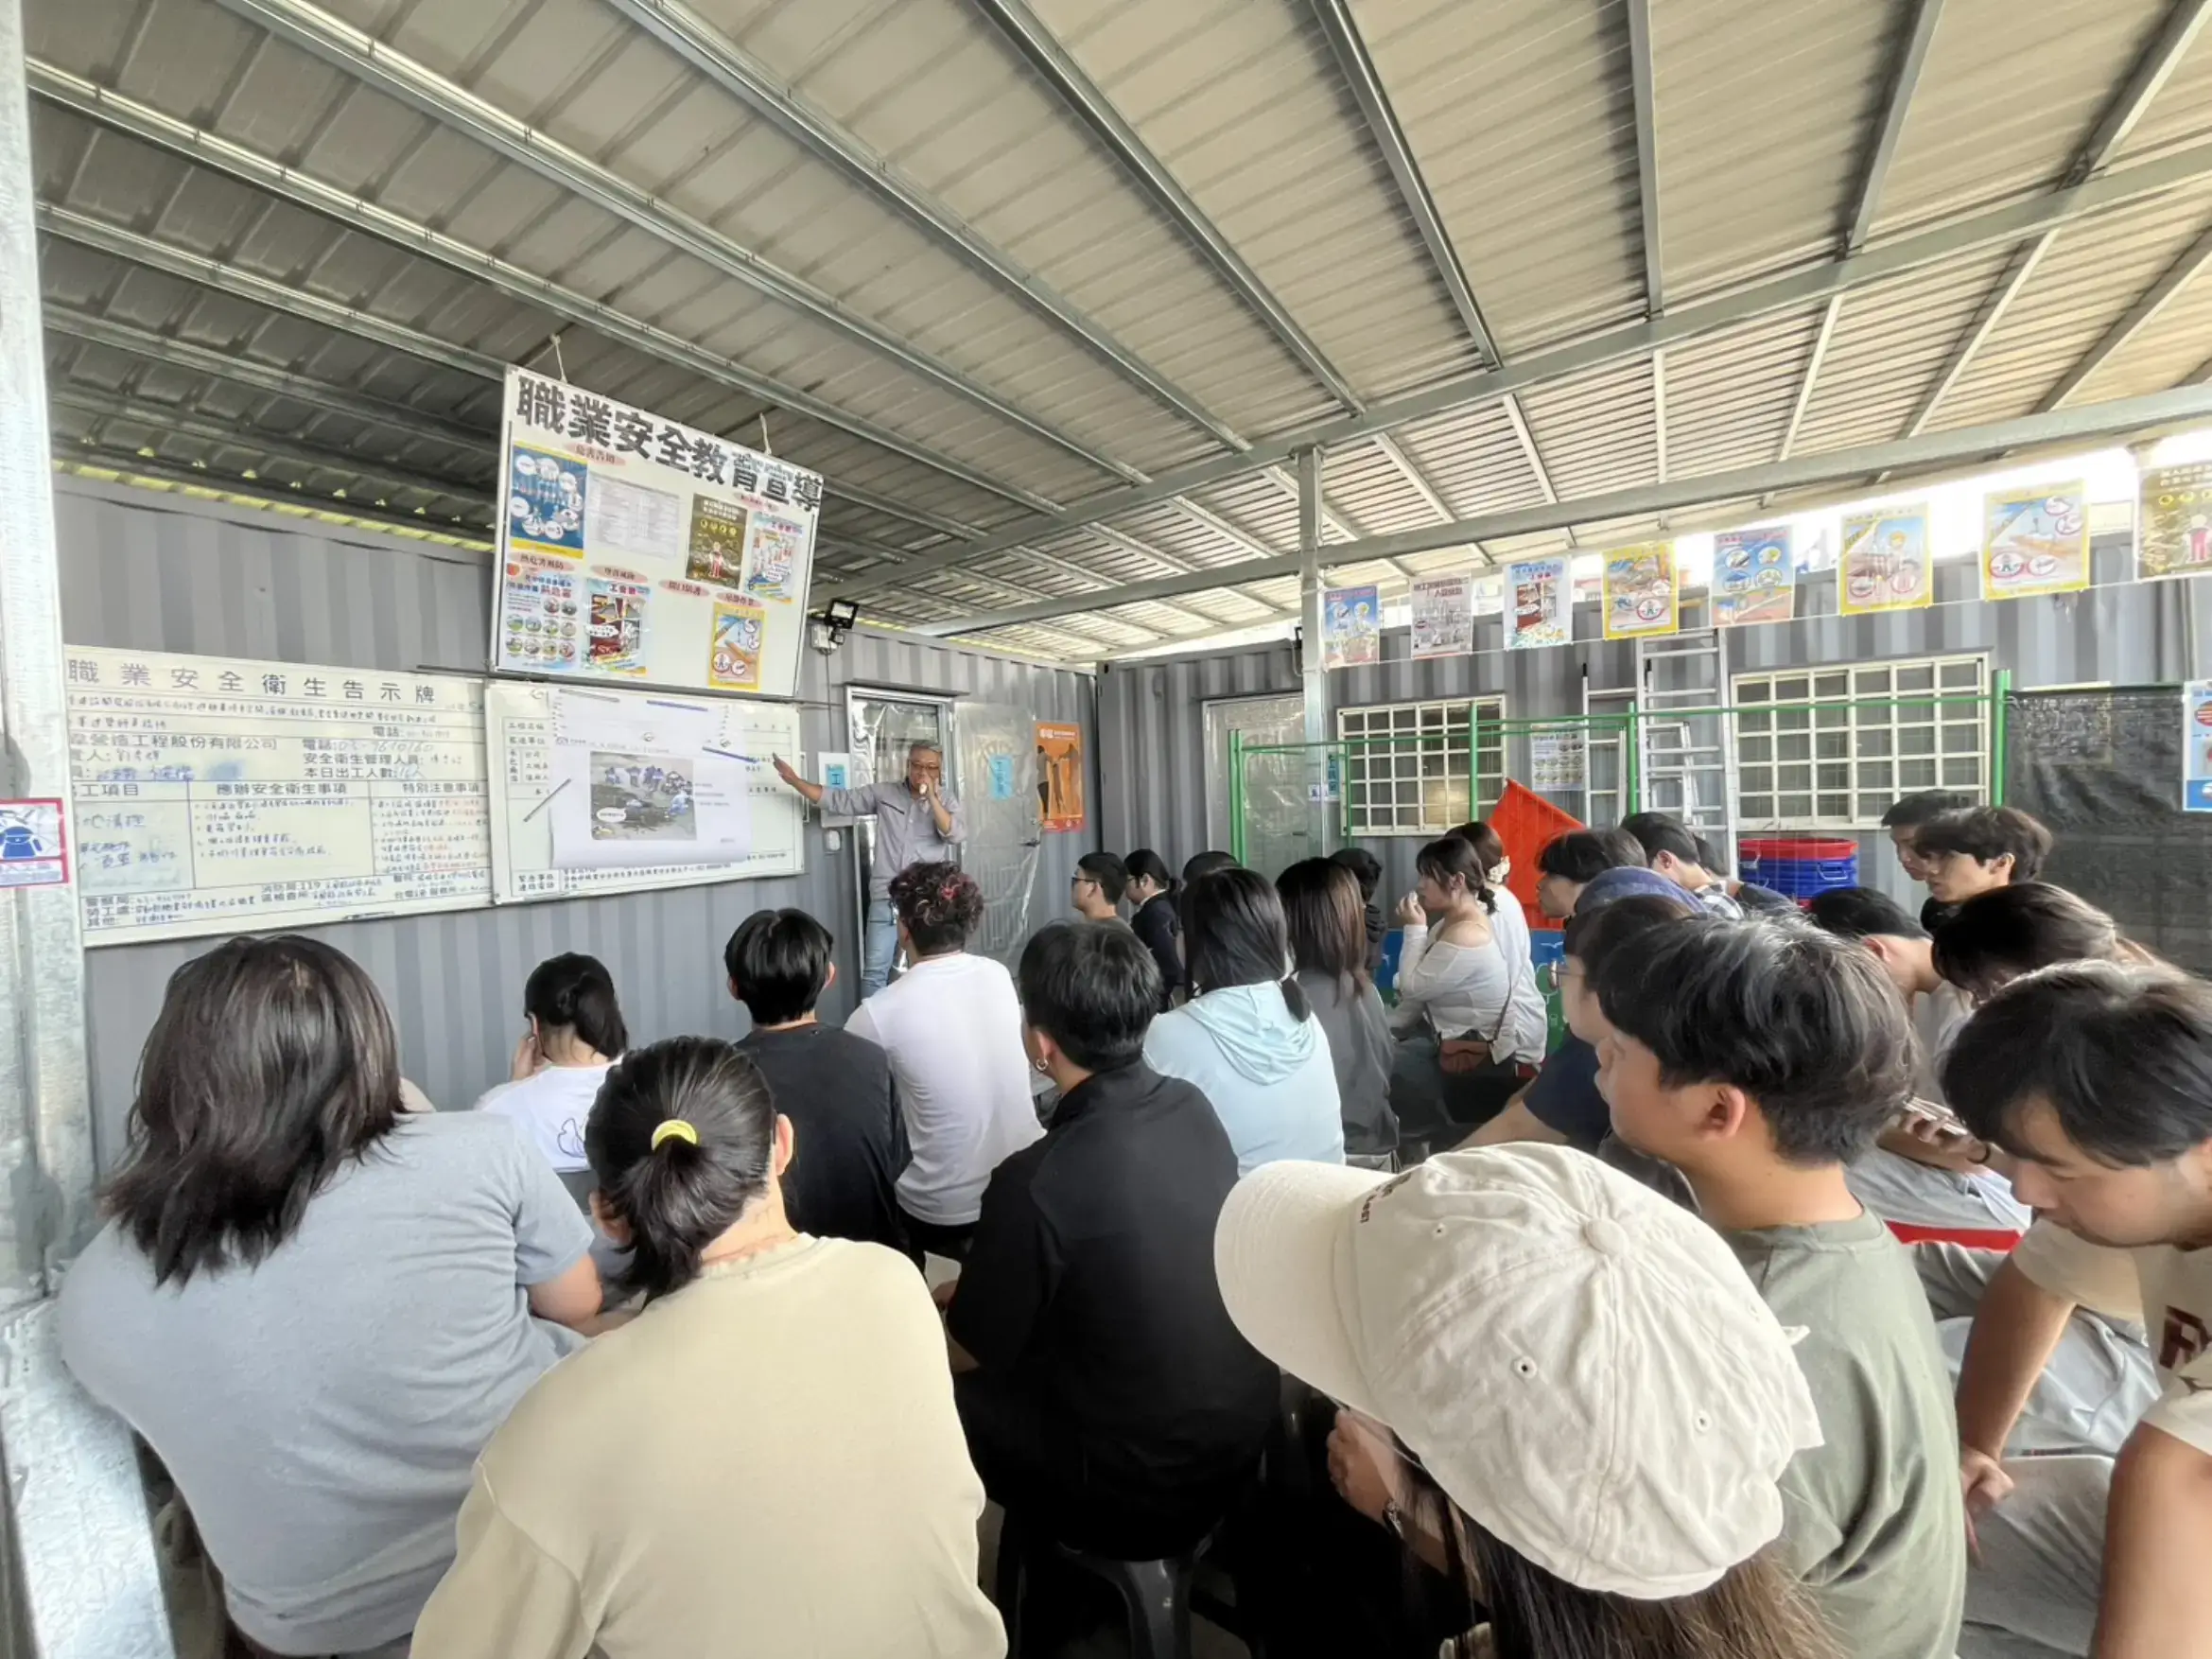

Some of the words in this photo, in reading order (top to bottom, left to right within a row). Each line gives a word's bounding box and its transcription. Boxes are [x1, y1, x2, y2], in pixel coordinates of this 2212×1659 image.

[516, 375, 825, 512] 職業安全教育宣導
[68, 658, 436, 704] 職業安全衛生告示牌
